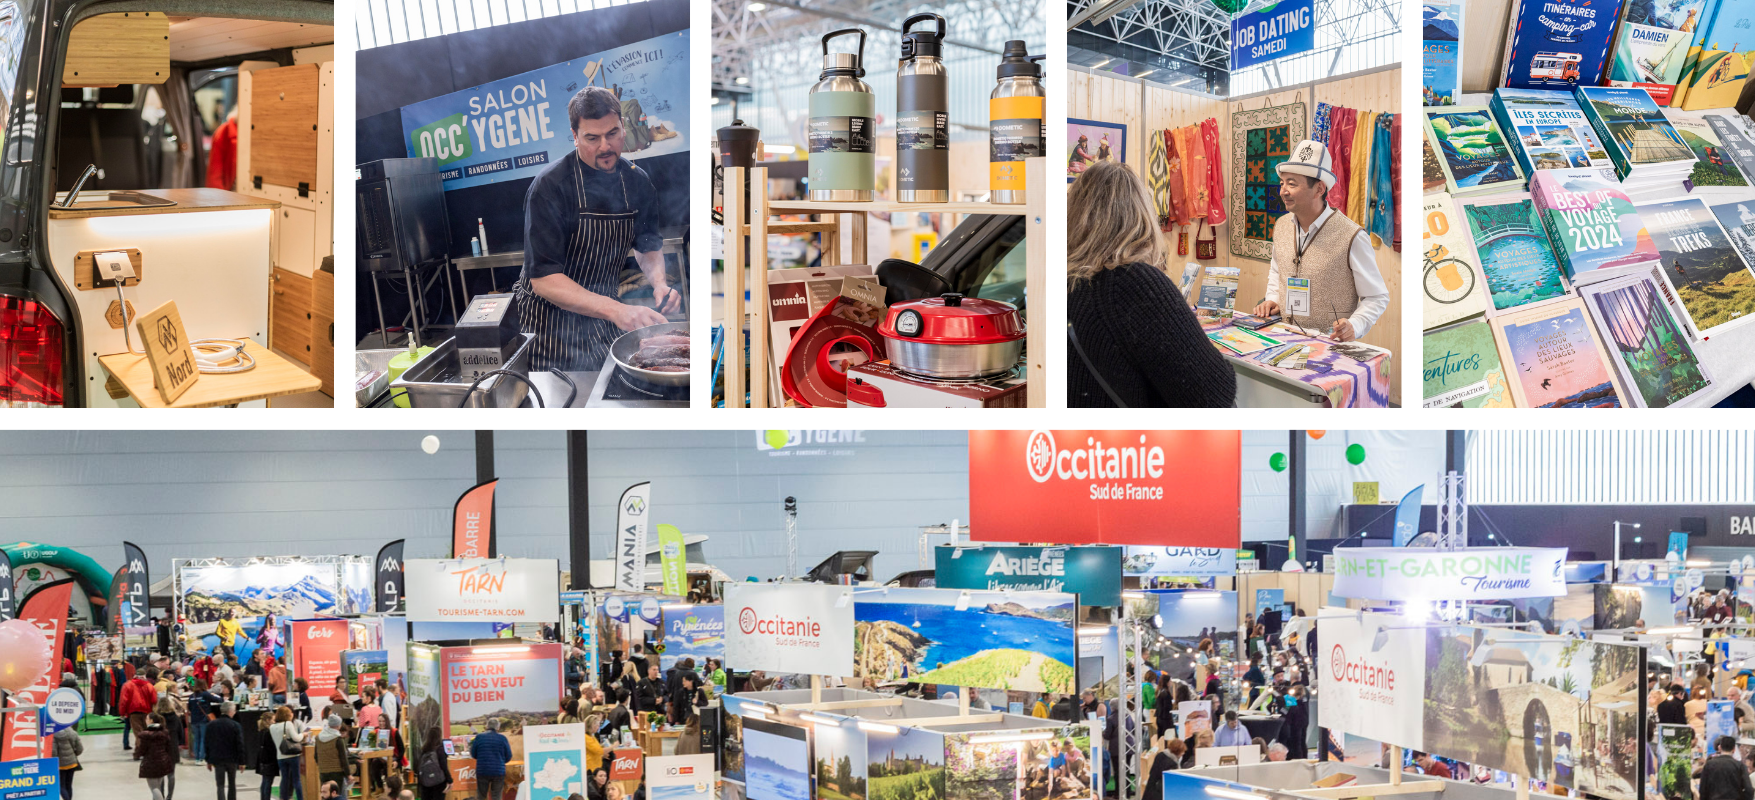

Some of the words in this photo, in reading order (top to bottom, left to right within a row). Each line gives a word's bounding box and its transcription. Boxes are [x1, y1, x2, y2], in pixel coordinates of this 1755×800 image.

[1544, 3, 1596, 18] ITINÉRAIRES
[1234, 24, 1256, 50] JOB
[1259, 7, 1310, 42] DATING
[1539, 14, 1596, 36] camping-car
[1632, 28, 1670, 43] DAMIEN
[1251, 38, 1287, 58] SAMEDI
[469, 79, 547, 115] SALON
[1513, 109, 1534, 119] ÎLES
[1538, 110, 1581, 119] SECRÈTES
[420, 102, 554, 160] OCC'YGENE
[1456, 152, 1500, 160] VOYAGES
[440, 170, 459, 180] RISME
[468, 161, 508, 175] RANDONNÉES
[518, 154, 545, 166] LOISIRS
[1552, 192, 1590, 210] BEST
[1596, 190, 1612, 205] OF
[1559, 206, 1621, 227] VOYAGE
[1655, 209, 1695, 225] FRANCE
[1568, 224, 1623, 252] 2024
[1670, 232, 1712, 254] TREKS
[1494, 247, 1538, 258] VOYAGES
[1500, 259, 1542, 270] ARTISTIQUES
[772, 292, 806, 306] omnia
[850, 289, 877, 302] OMNIA
[1659, 281, 1675, 306] FRANCE
[1534, 330, 1567, 343] VOYAGES
[1539, 337, 1567, 350] AUTOUR
[1537, 349, 1551, 357] DES
[1552, 342, 1573, 352] LIEUX
[1539, 349, 1576, 364] SAUVAGES
[1635, 340, 1678, 363] VOYAGES
[166, 350, 192, 389] Nord
[1445, 385, 1485, 402] NAVIGATION
[1026, 430, 1164, 482] Occitanie
[1089, 484, 1109, 500] Sud
[1111, 484, 1123, 499] de
[1126, 484, 1163, 500] France
[1730, 516, 1755, 535] BA
[622, 525, 636, 588] MANIA
[986, 550, 1065, 576] ARIÈGE
[450, 566, 507, 596] TARN
[1461, 575, 1531, 592] Tourisme
[739, 607, 820, 637] Occitanie
[307, 626, 334, 639] Gers
[775, 637, 788, 646] Sud
[790, 638, 797, 646] de
[798, 639, 820, 648] France
[451, 665, 466, 677] LE
[468, 664, 504, 676] TARN
[1331, 644, 1395, 690] Occitanie
[452, 677, 489, 690] VOUS
[492, 676, 525, 688] VEUT
[452, 692, 472, 703] DU
[474, 690, 504, 702] BIEN
[1359, 690, 1370, 700] Sud
[1370, 692, 1377, 702] de
[1378, 694, 1394, 705] France
[612, 757, 640, 771] TARN
[454, 766, 477, 781] TAR
[0, 778, 33, 789] GRAND
[36, 775, 55, 786] JEU
